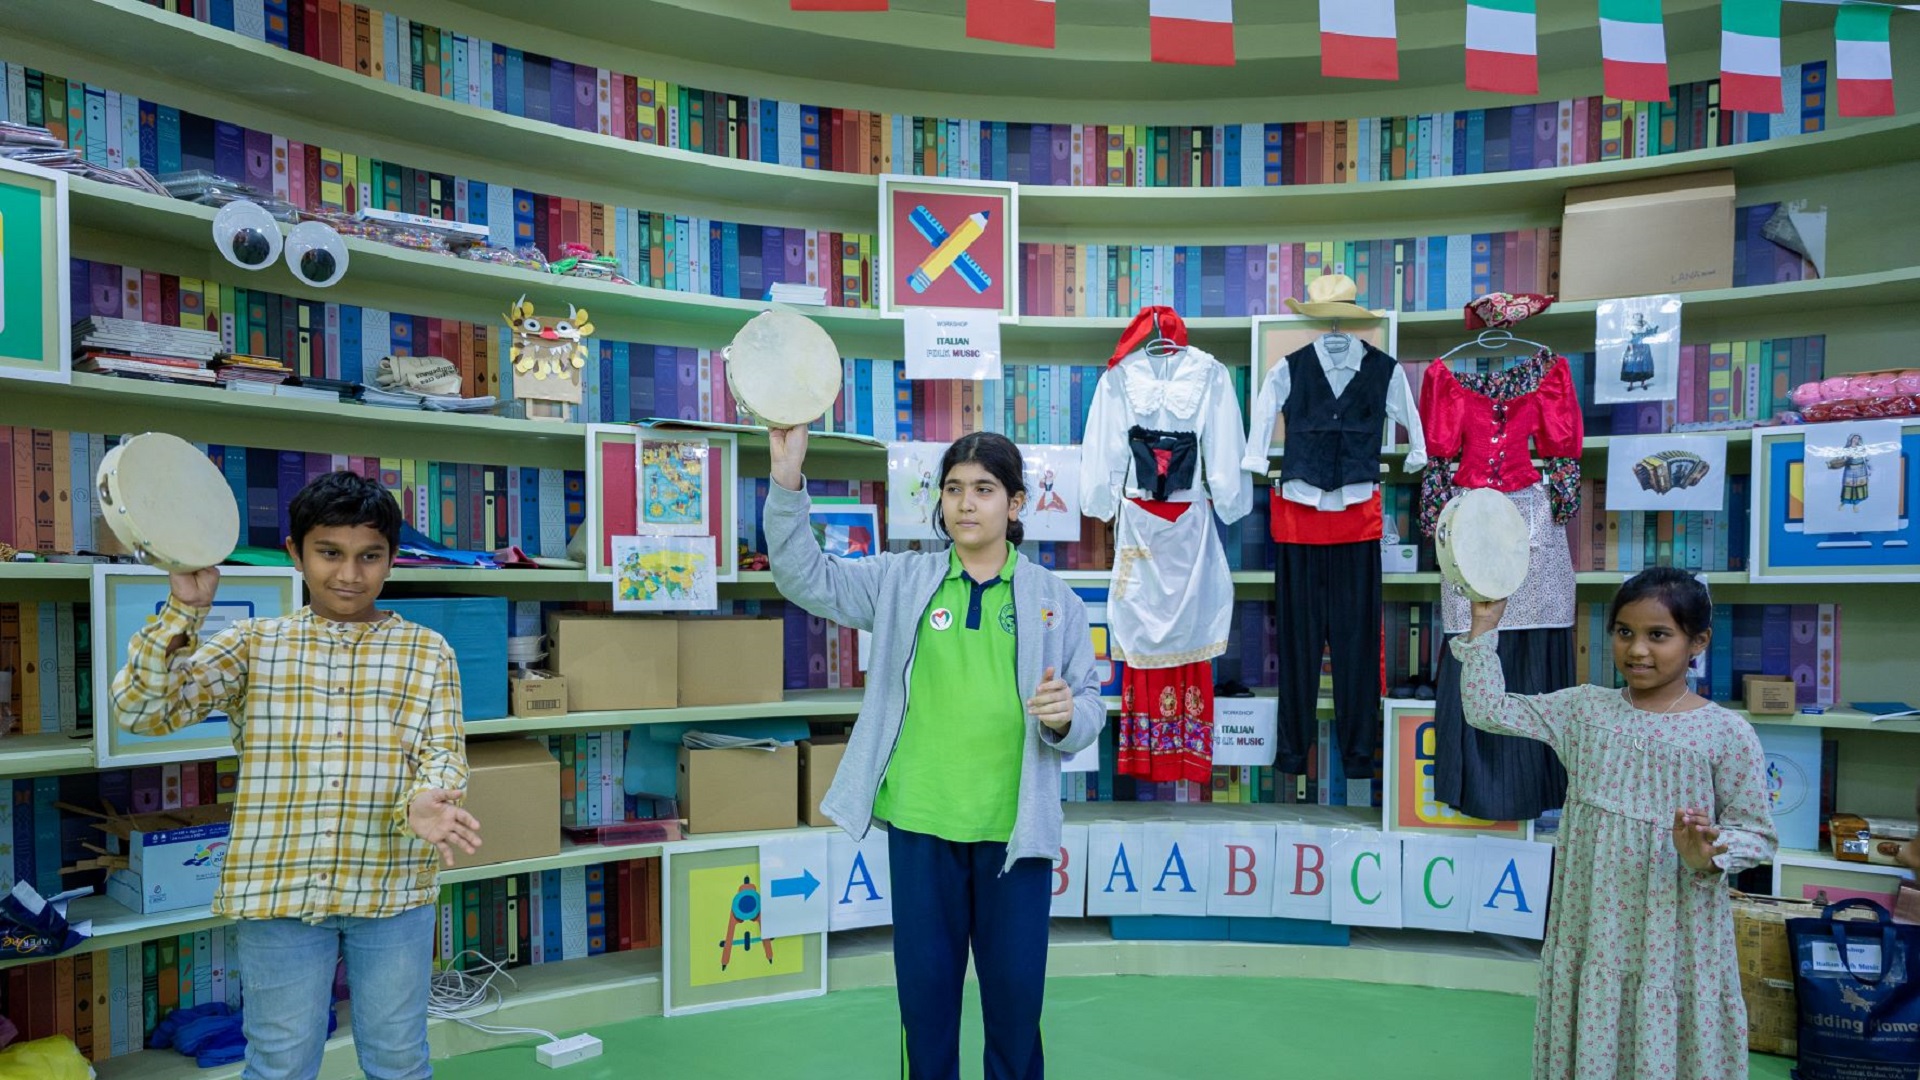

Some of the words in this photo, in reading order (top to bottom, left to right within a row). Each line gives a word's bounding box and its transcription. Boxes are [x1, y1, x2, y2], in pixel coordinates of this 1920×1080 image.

[936, 337, 970, 346] ITALIAN
[926, 349, 951, 358] FOLK
[952, 349, 981, 358] MUSIC
[1221, 725, 1255, 735] ITALIAN
[1236, 737, 1265, 746] MUSIC
[838, 850, 884, 905] A
[1103, 842, 1139, 893] A
[1152, 842, 1197, 893] A
[1223, 845, 1257, 896] B
[1289, 843, 1325, 896] B
[1350, 851, 1382, 905] C
[1423, 856, 1455, 909] C
[1482, 857, 1533, 914] A
[1815, 960, 1840, 968] Italian
[1858, 963, 1879, 971] Music
